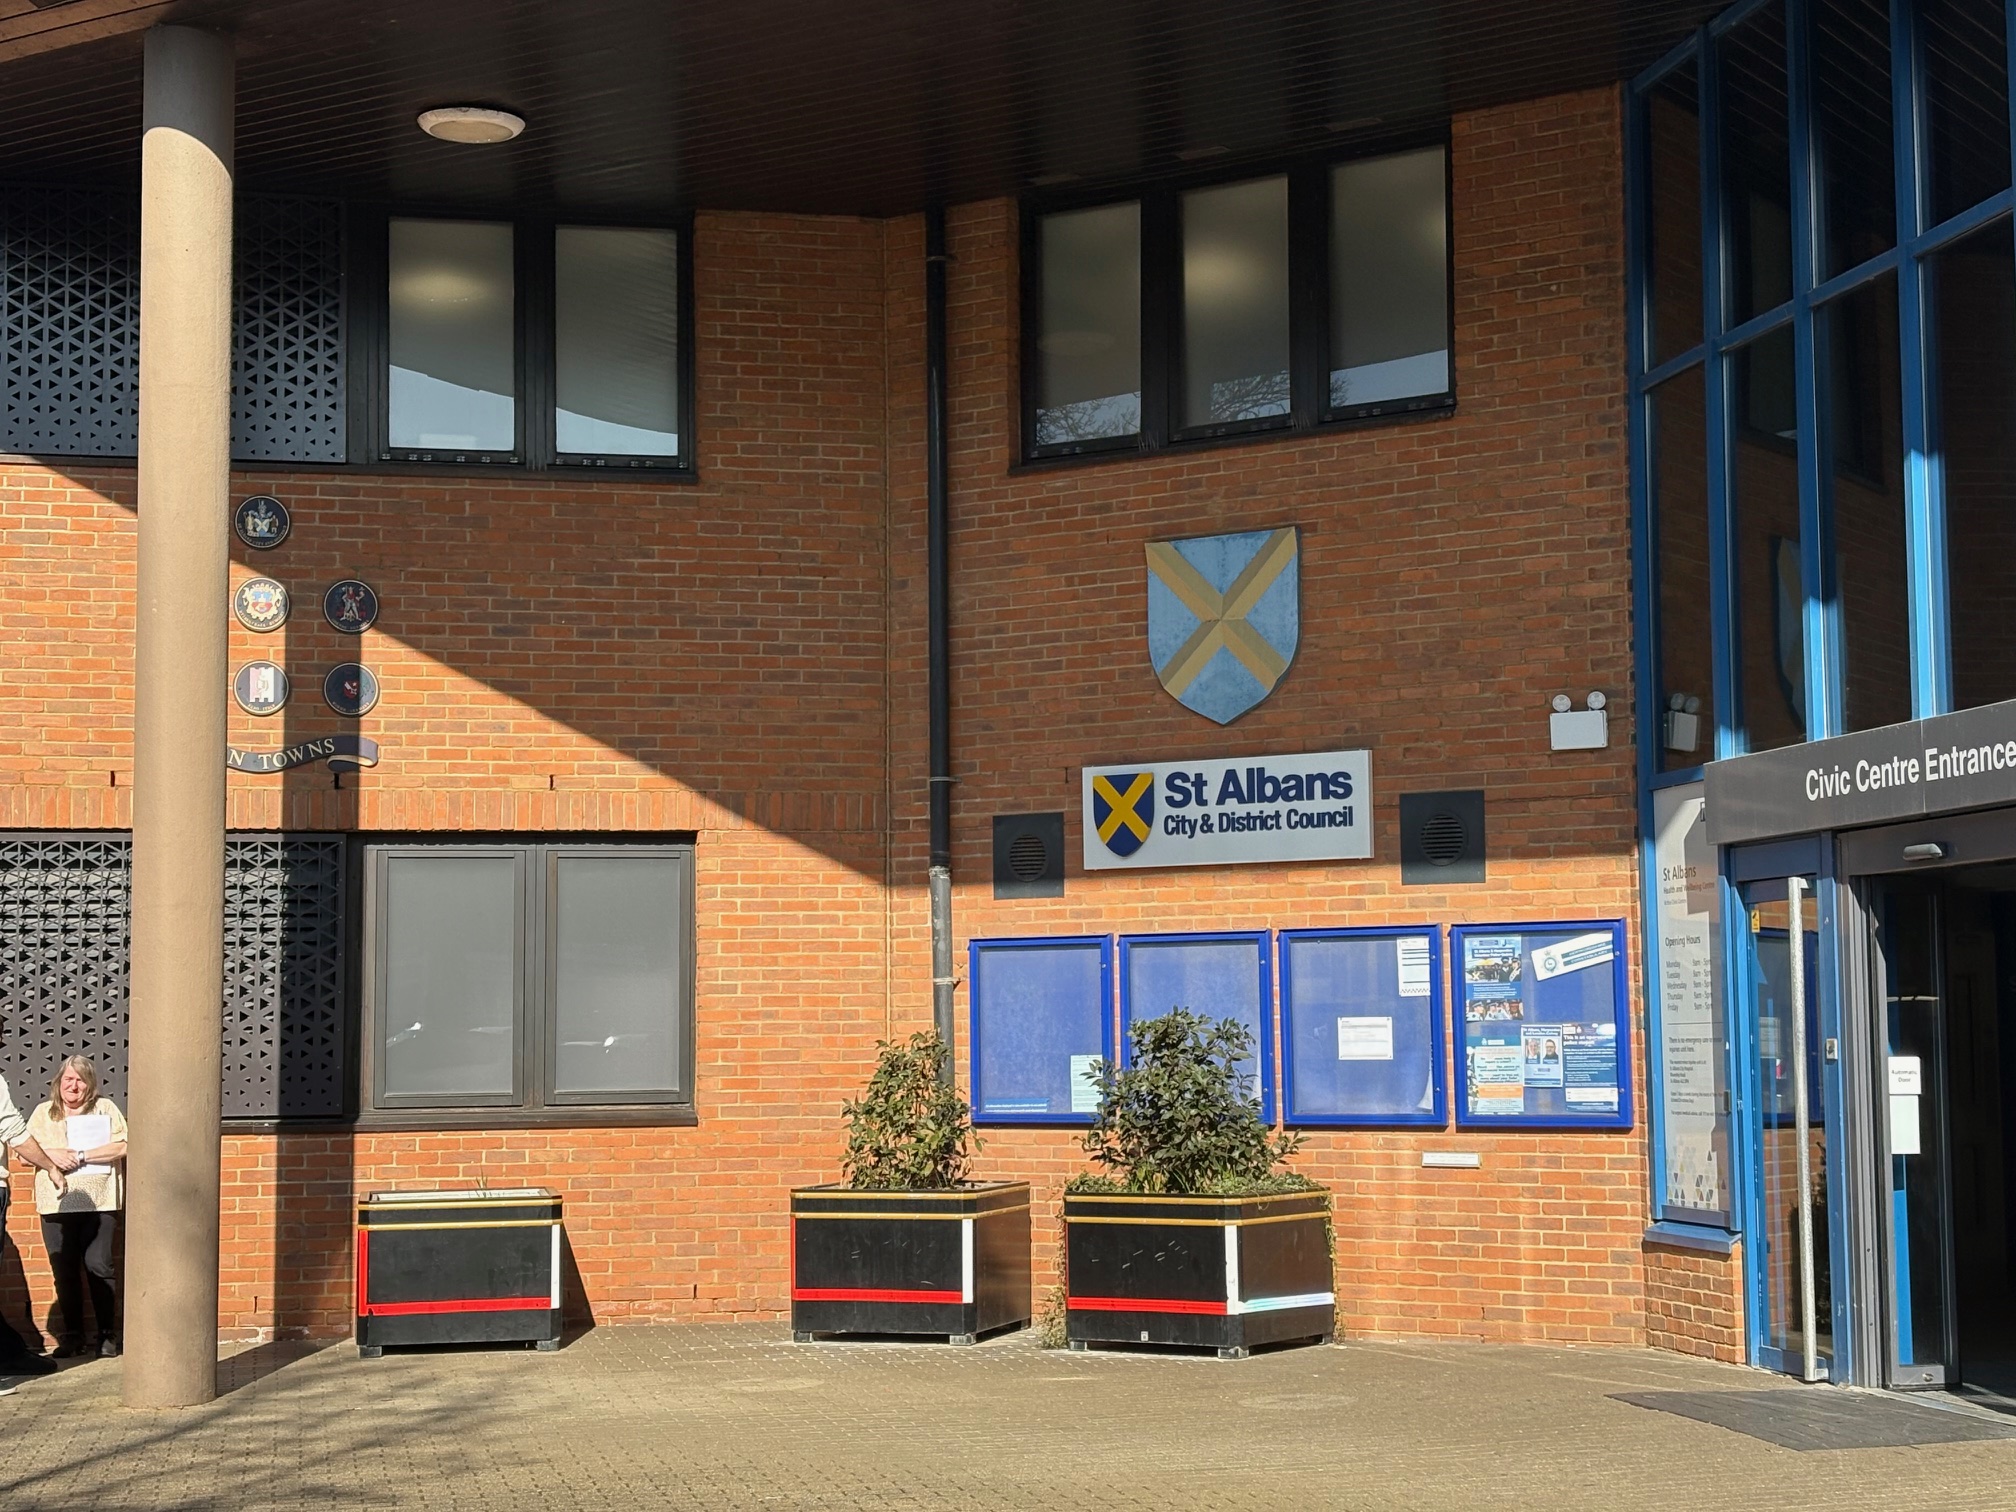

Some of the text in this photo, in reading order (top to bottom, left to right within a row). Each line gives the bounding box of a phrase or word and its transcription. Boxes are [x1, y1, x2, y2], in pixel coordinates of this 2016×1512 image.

[258, 738, 335, 770] TOWNS
[1805, 740, 2016, 802] Civic Centre Entrance
[1164, 766, 1353, 809] St Albans
[1164, 806, 1354, 838] City & District Council
[1663, 865, 1696, 881] St Albans
[1664, 886, 1675, 894] Health
[1665, 935, 1700, 948] Opening Hours
[1666, 960, 1680, 969] Monday
[1666, 971, 1680, 980] Tuesday
[1667, 982, 1687, 990] Wednesday
[1667, 992, 1683, 1002] Thursday
[1668, 1003, 1678, 1012] Friday
